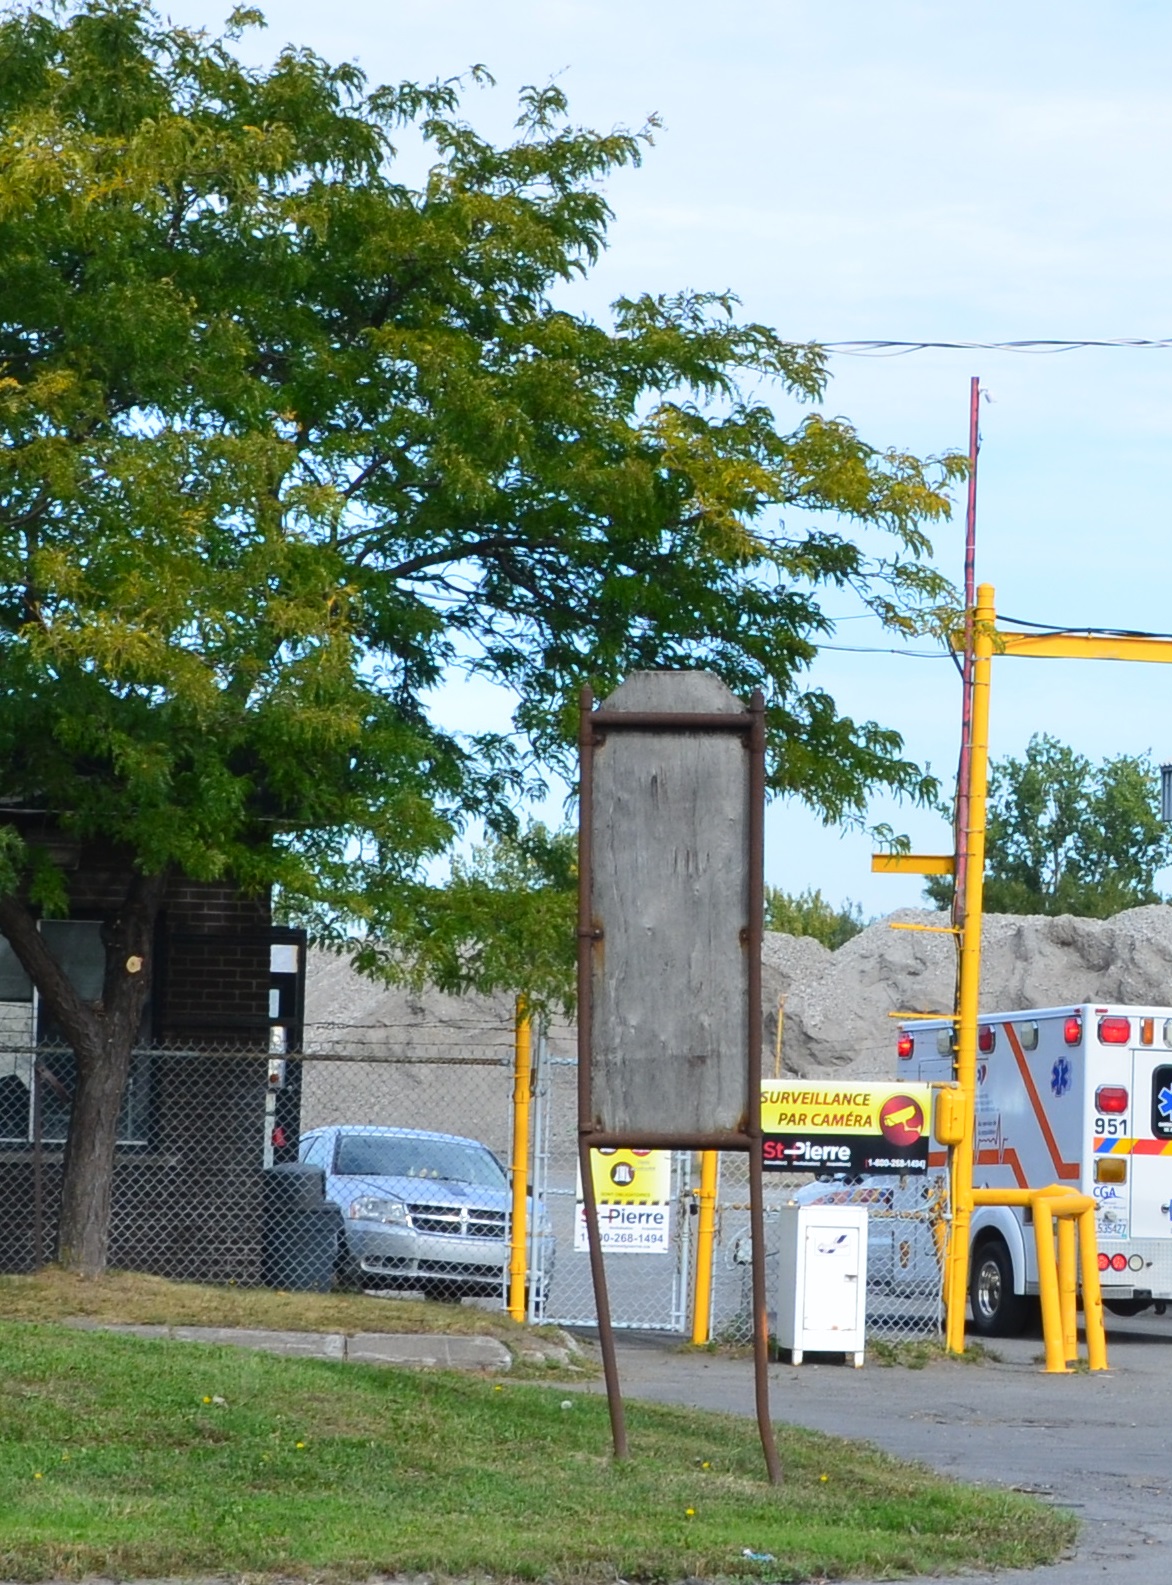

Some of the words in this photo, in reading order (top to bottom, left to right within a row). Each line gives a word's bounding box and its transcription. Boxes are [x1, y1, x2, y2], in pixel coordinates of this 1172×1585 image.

[760, 1091, 871, 1107] SURVEILLANCE
[778, 1112, 807, 1126] PAR
[811, 1111, 873, 1127] CAMÉRA
[1094, 1117, 1127, 1136] 951
[763, 1141, 851, 1161] St-Pierre
[1093, 1185, 1117, 1199] CGA
[581, 1207, 664, 1224] S-Pierre
